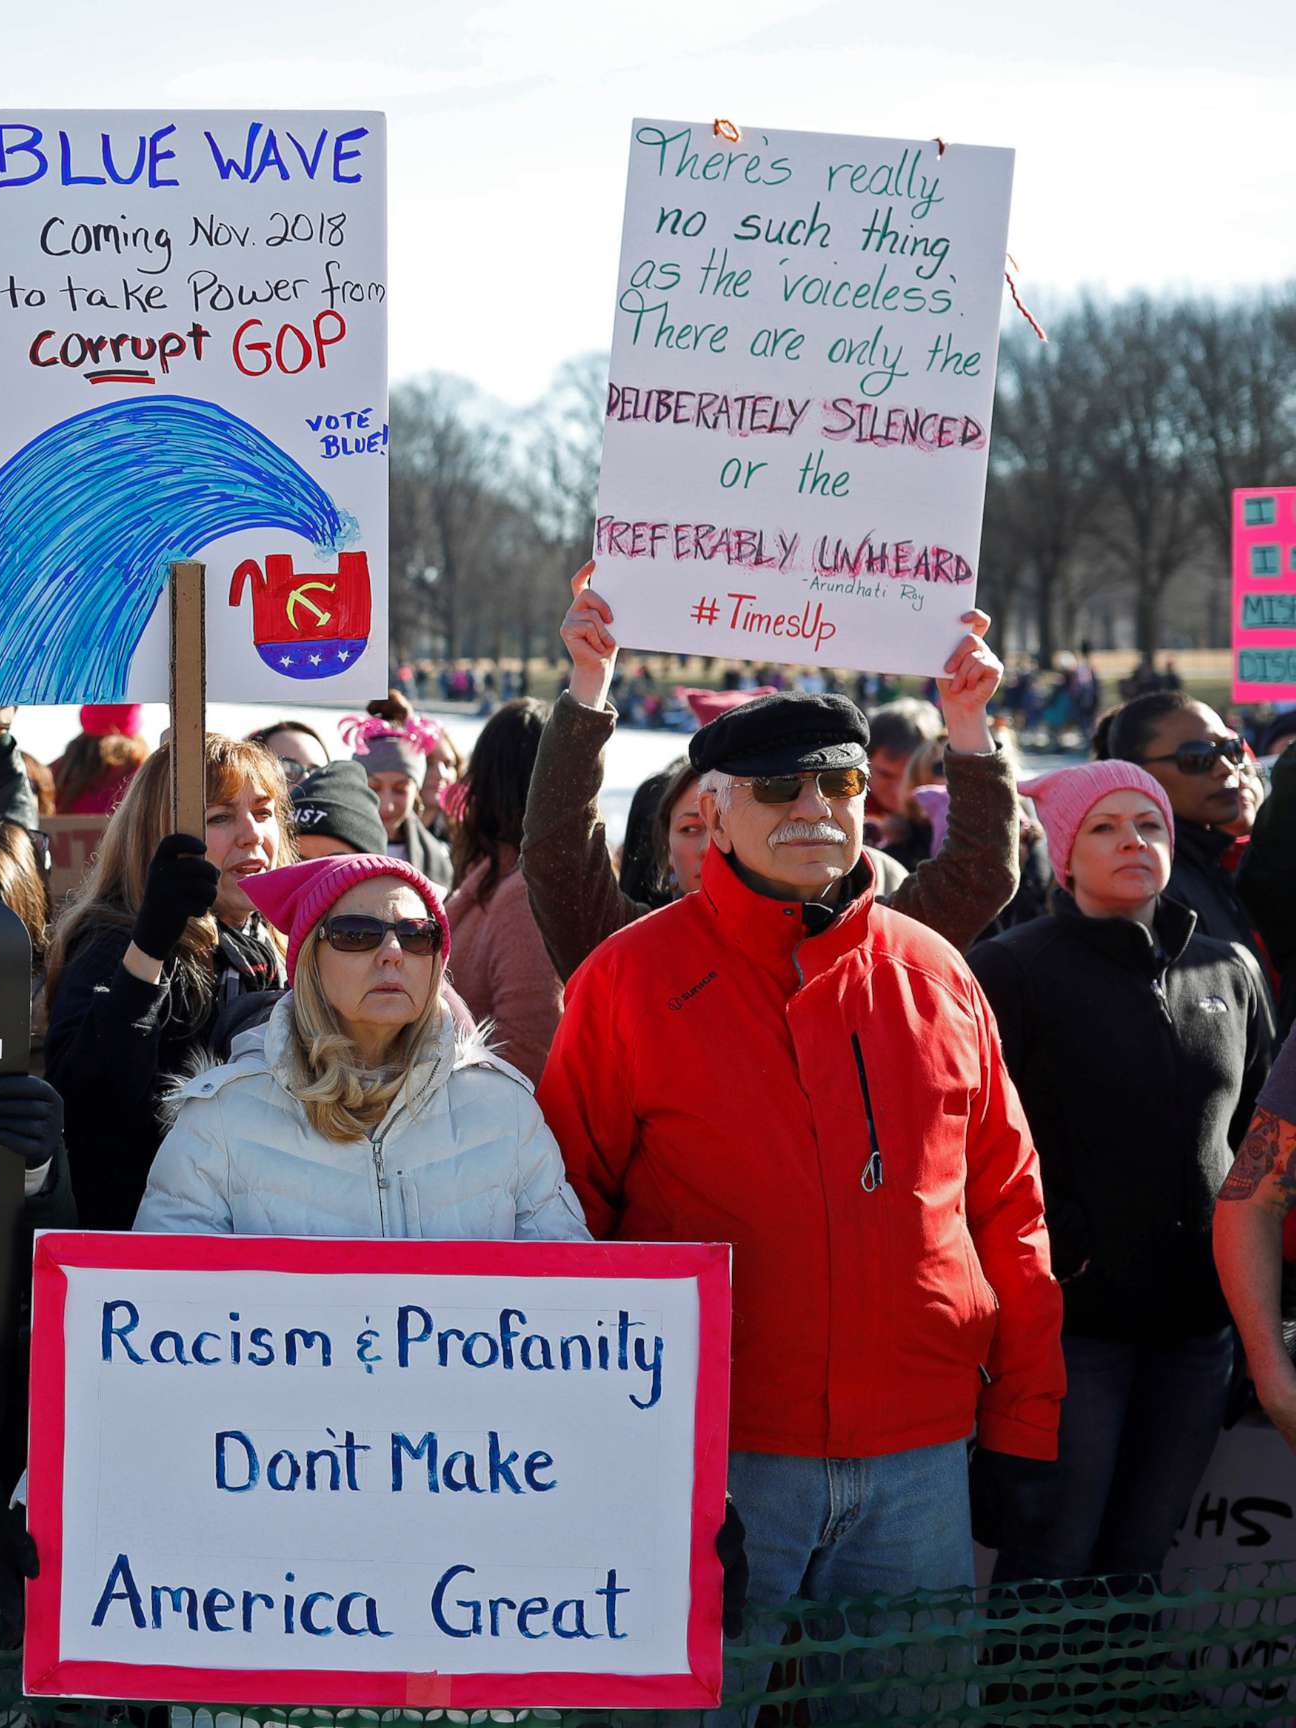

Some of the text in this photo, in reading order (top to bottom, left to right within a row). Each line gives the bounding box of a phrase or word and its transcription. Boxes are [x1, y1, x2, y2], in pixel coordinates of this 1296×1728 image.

[204, 121, 370, 184] WAVE
[636, 126, 945, 220] There's really
[40, 211, 347, 275] Coming Nov. 2018
[630, 259, 681, 291] as
[700, 247, 752, 297] the
[655, 201, 951, 280] no such thing
[0, 260, 386, 313] to take Power from
[232, 309, 347, 377] GOP
[619, 288, 982, 397] There are only the
[305, 407, 373, 432] VOTE
[320, 424, 389, 459] BLUE!
[605, 381, 985, 449] DELIBERATELY SILENCED
[720, 449, 850, 497] or the
[595, 515, 974, 585] PREFERABLY UNHEARD
[690, 593, 837, 653] #TimesUp
[900, 584, 926, 611] Roy
[102, 1299, 332, 1367] Racism
[396, 1303, 664, 1411] Profanity
[215, 1426, 558, 1496] Don't Make
[90, 1553, 632, 1640] America Great
